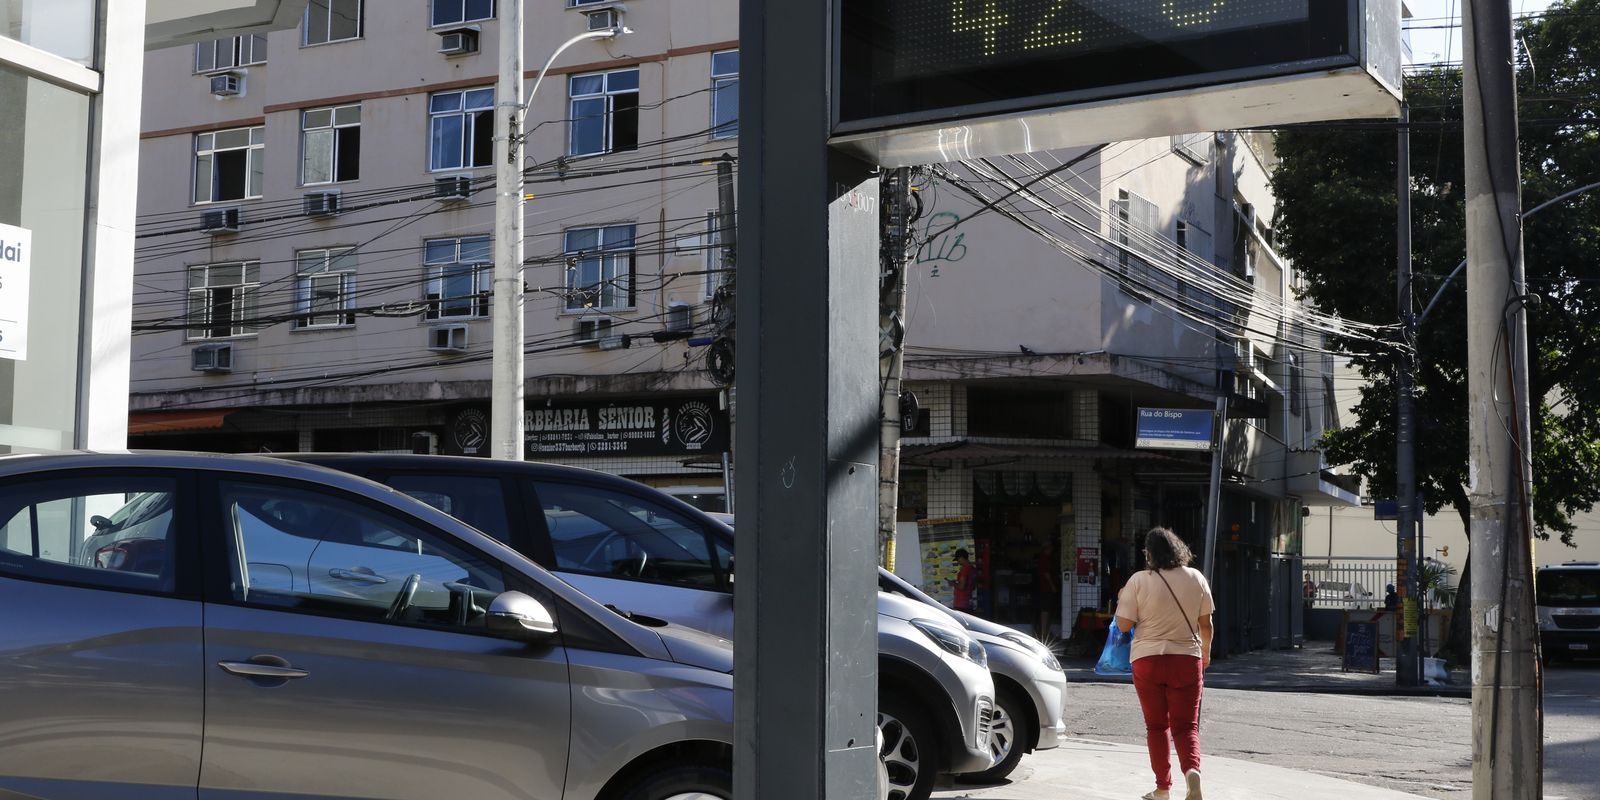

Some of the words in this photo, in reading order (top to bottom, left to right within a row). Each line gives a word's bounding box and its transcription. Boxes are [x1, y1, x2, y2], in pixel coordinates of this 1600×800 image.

[953, 0, 1082, 56] 42
[524, 409, 590, 431] RBEARIA
[599, 403, 655, 430] SÊNIOR
[1164, 410, 1183, 419] Bispo
